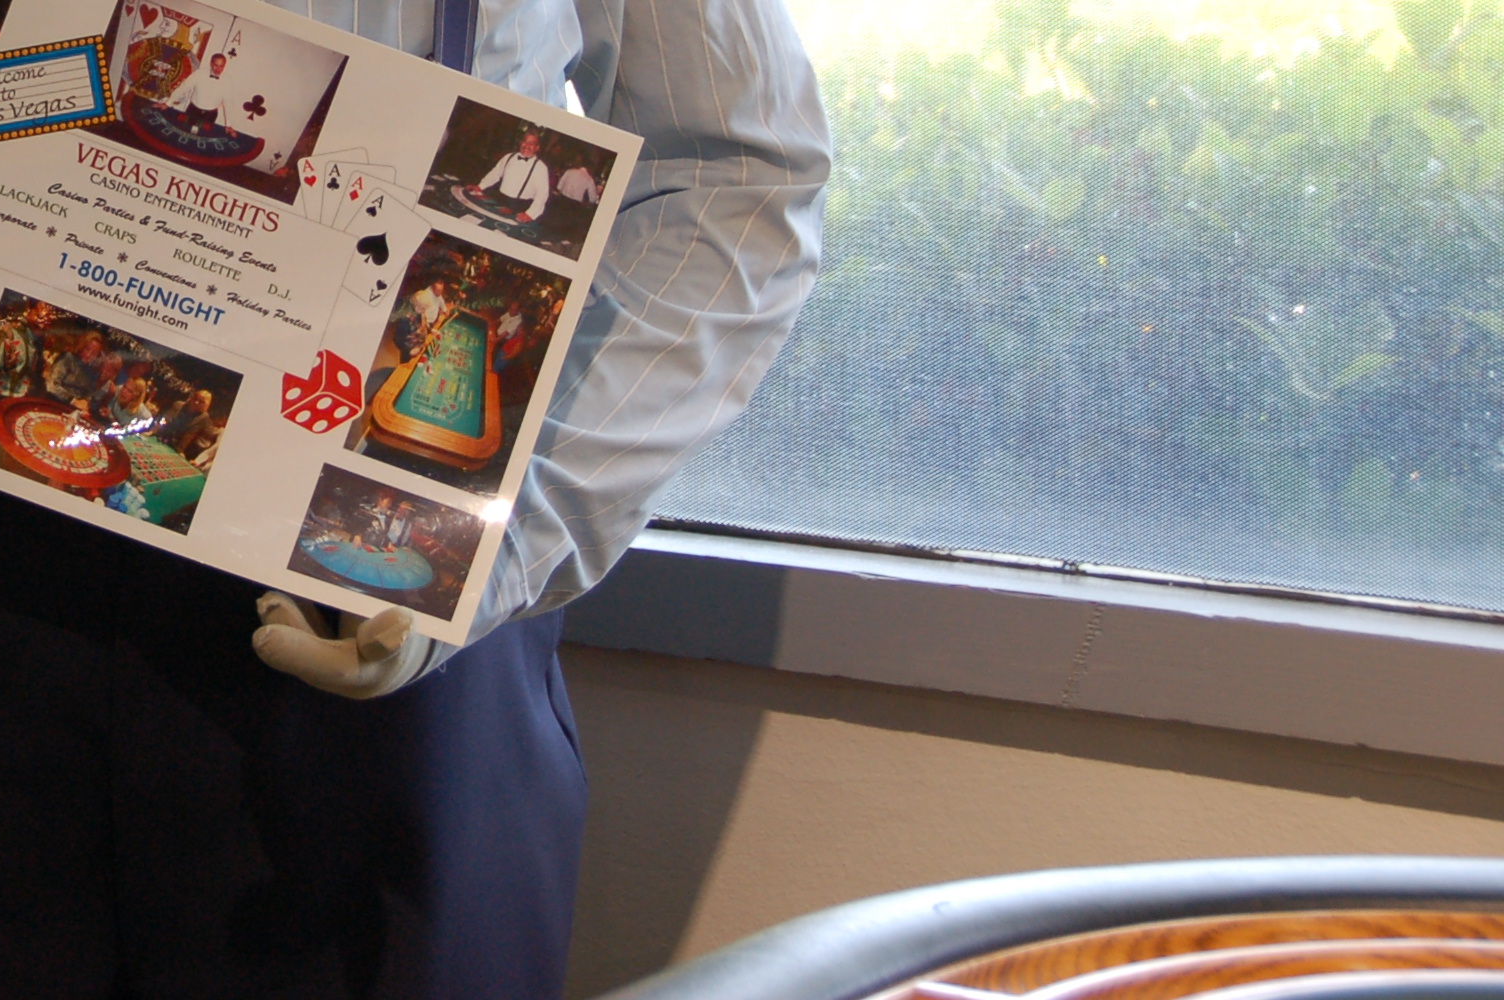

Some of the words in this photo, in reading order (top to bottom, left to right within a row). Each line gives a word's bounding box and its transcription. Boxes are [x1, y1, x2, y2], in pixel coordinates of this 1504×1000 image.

[231, 29, 243, 46] A
[0, 87, 16, 102] to
[9, 95, 77, 125] Vegas
[302, 159, 315, 174] A
[328, 163, 342, 178] A
[351, 176, 364, 191] A
[76, 142, 159, 189] VEGAS
[165, 175, 280, 233] KNIGHTS
[89, 172, 141, 199] CASINO
[143, 192, 253, 239] ENTERTAINMENT
[372, 195, 385, 209] A
[47, 183, 89, 204] Casino
[92, 197, 135, 222] Parties
[139, 215, 152, 226] &
[153, 219, 235, 260] Fund-Raising
[238, 251, 278, 273] Events
[94, 221, 137, 245] CRAPS
[172, 248, 242, 282] ROULETTE
[267, 283, 292, 302] D.J.
[57, 252, 226, 326] 1-800-FUNIGHT
[64, 232, 105, 255] Private
[134, 260, 198, 289] Conventions
[226, 292, 270, 318] Holiday
[273, 308, 312, 331] Parties
[77, 282, 189, 331] www.funight.com
